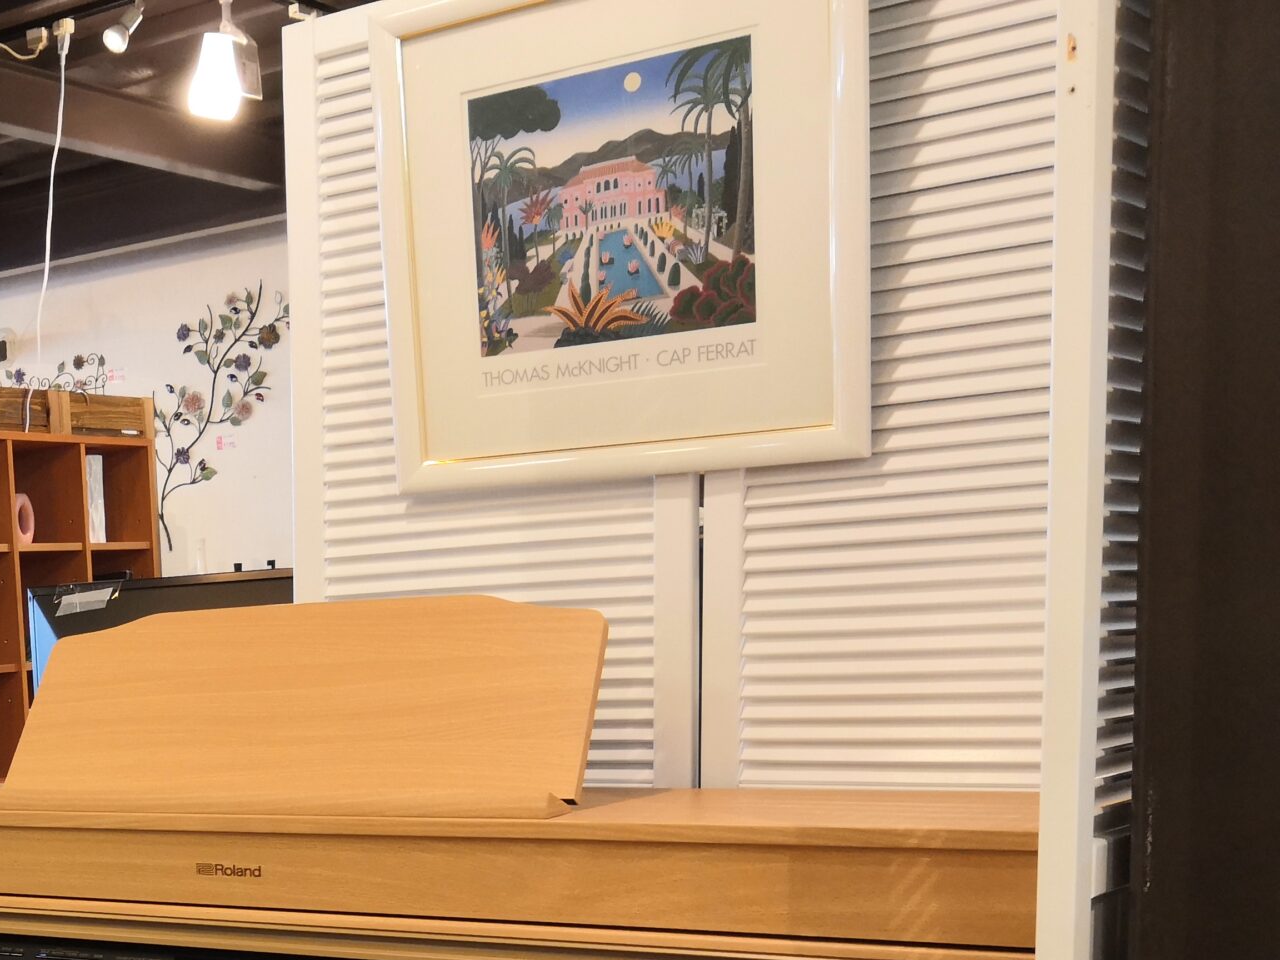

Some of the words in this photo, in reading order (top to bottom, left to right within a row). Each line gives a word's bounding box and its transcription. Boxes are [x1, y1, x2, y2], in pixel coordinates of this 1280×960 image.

[482, 364, 550, 388] THOMAS
[556, 353, 640, 380] McKNIGHT
[656, 347, 691, 368] CAP
[697, 339, 757, 363] FERRAT
[214, 863, 262, 878] Roland
